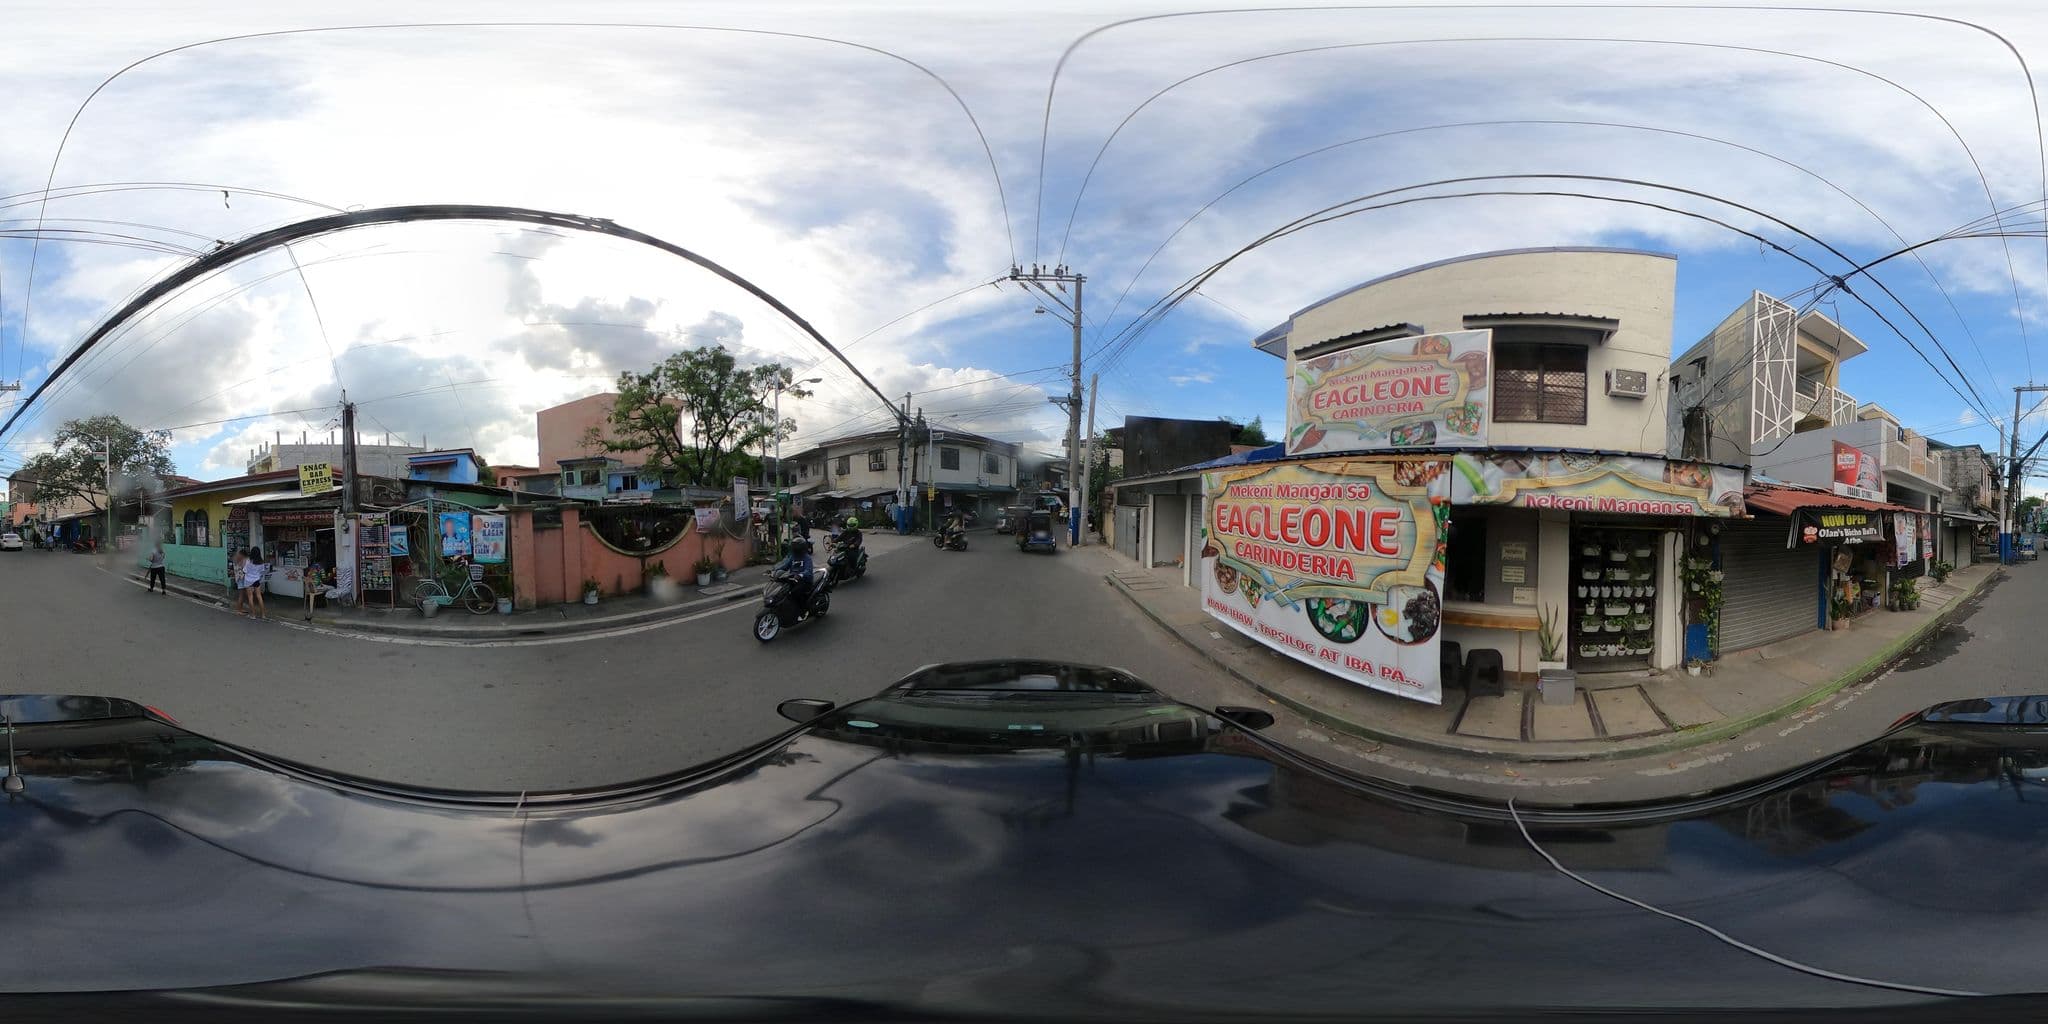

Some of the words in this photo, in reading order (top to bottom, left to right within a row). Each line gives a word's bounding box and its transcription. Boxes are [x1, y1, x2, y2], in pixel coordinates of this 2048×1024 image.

[1371, 366, 1418, 379] Mangan
[1420, 363, 1434, 372] sa
[1314, 374, 1451, 410] EAGLEONE
[1332, 401, 1424, 420] CARINDERIA
[303, 463, 327, 471] SNACK
[302, 477, 331, 486] EXPRESS
[1230, 484, 1273, 498] Mekeni
[1276, 484, 1343, 503] Mangan
[1347, 484, 1370, 499] sa
[1675, 502, 1693, 514] sa
[1215, 503, 1401, 556] EAGLEONE
[1821, 514, 1845, 527] NOW
[1846, 514, 1867, 525] OPEN
[1235, 540, 1355, 581] CARINDERIA
[1319, 648, 1339, 662] AT
[1345, 655, 1373, 674] IBA
